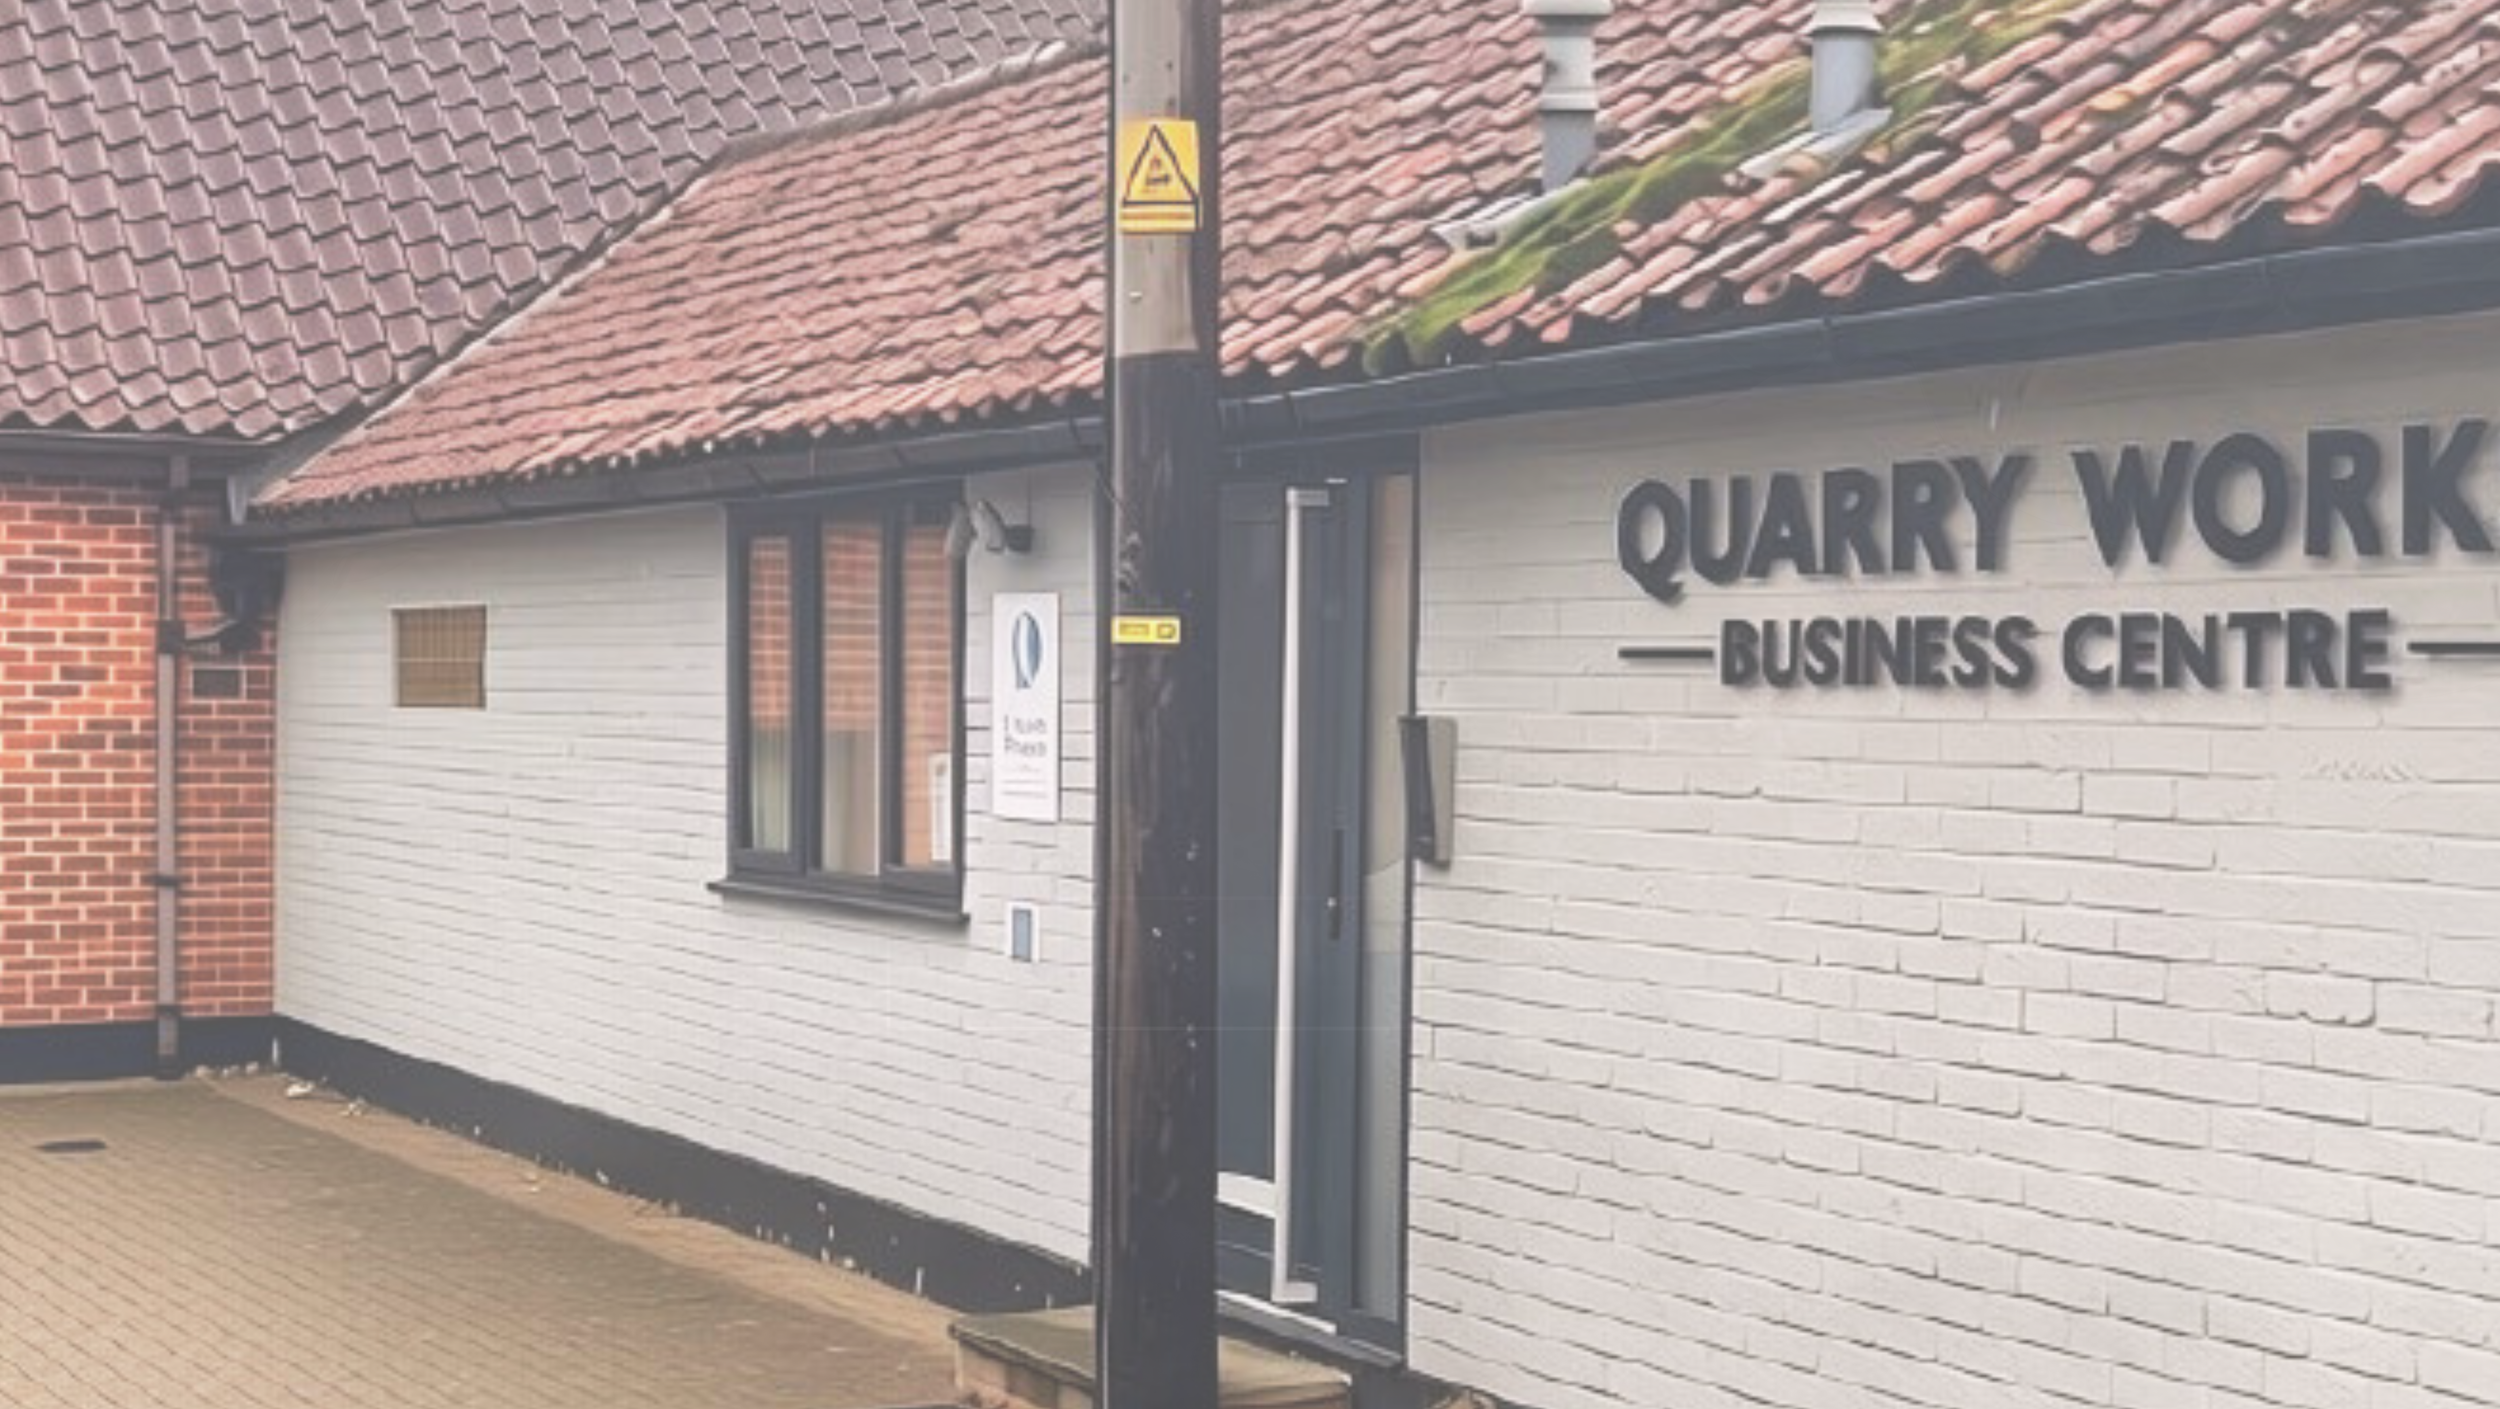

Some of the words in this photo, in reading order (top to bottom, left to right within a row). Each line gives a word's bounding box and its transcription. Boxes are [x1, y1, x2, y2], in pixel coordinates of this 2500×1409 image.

[1617, 453, 2032, 602] QUARRY
[2071, 420, 2498, 567] WORK
[1720, 614, 2036, 690] BUSINESS
[2063, 608, 2393, 690] CENTRE
